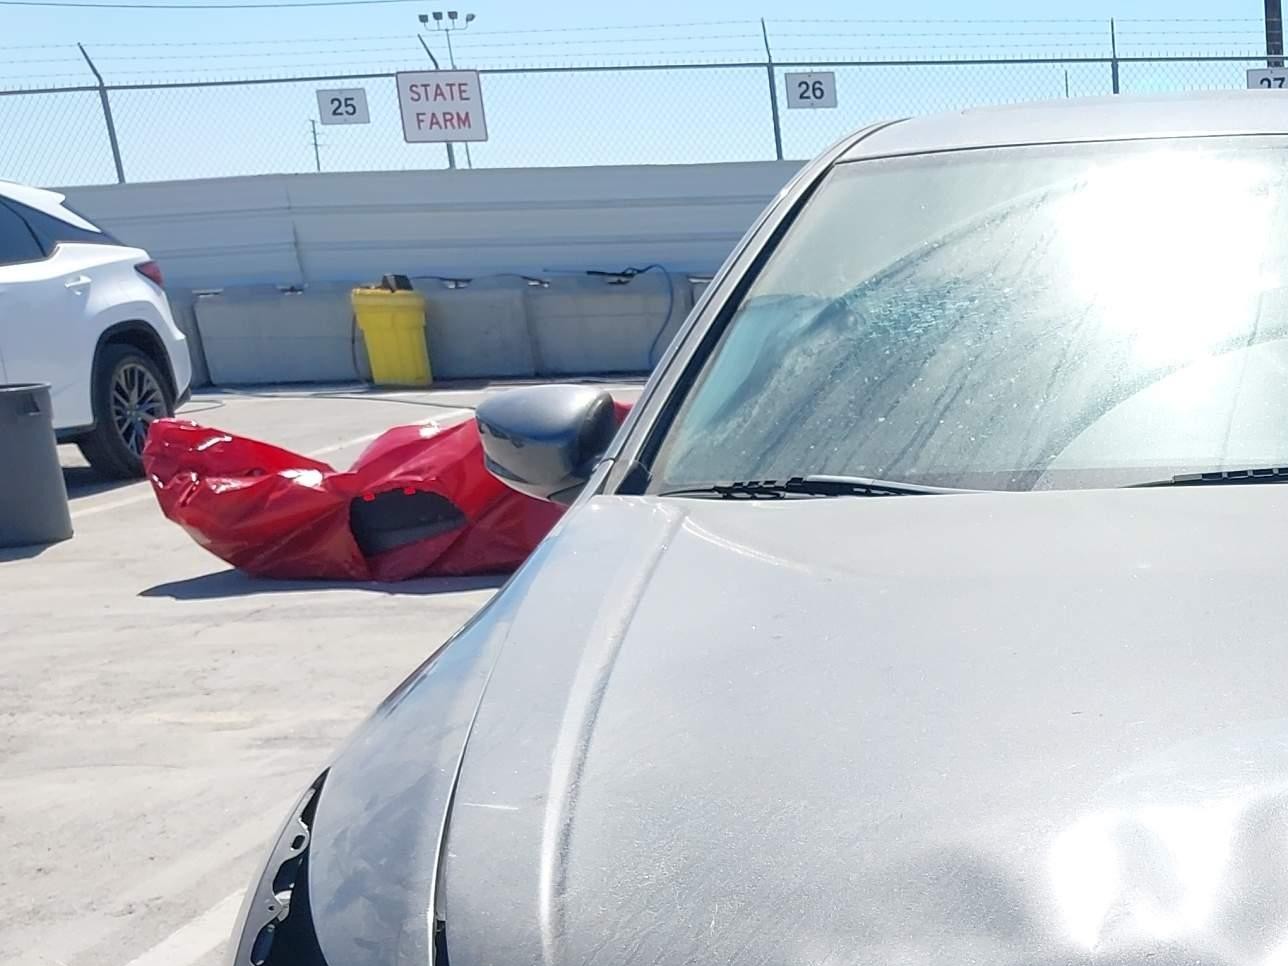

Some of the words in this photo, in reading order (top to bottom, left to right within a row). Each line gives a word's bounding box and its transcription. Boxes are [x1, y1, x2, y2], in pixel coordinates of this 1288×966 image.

[408, 82, 471, 103] STATE
[797, 80, 825, 100] 26
[1259, 77, 1286, 88] 27
[329, 97, 357, 117] 25
[415, 111, 472, 131] FARM
